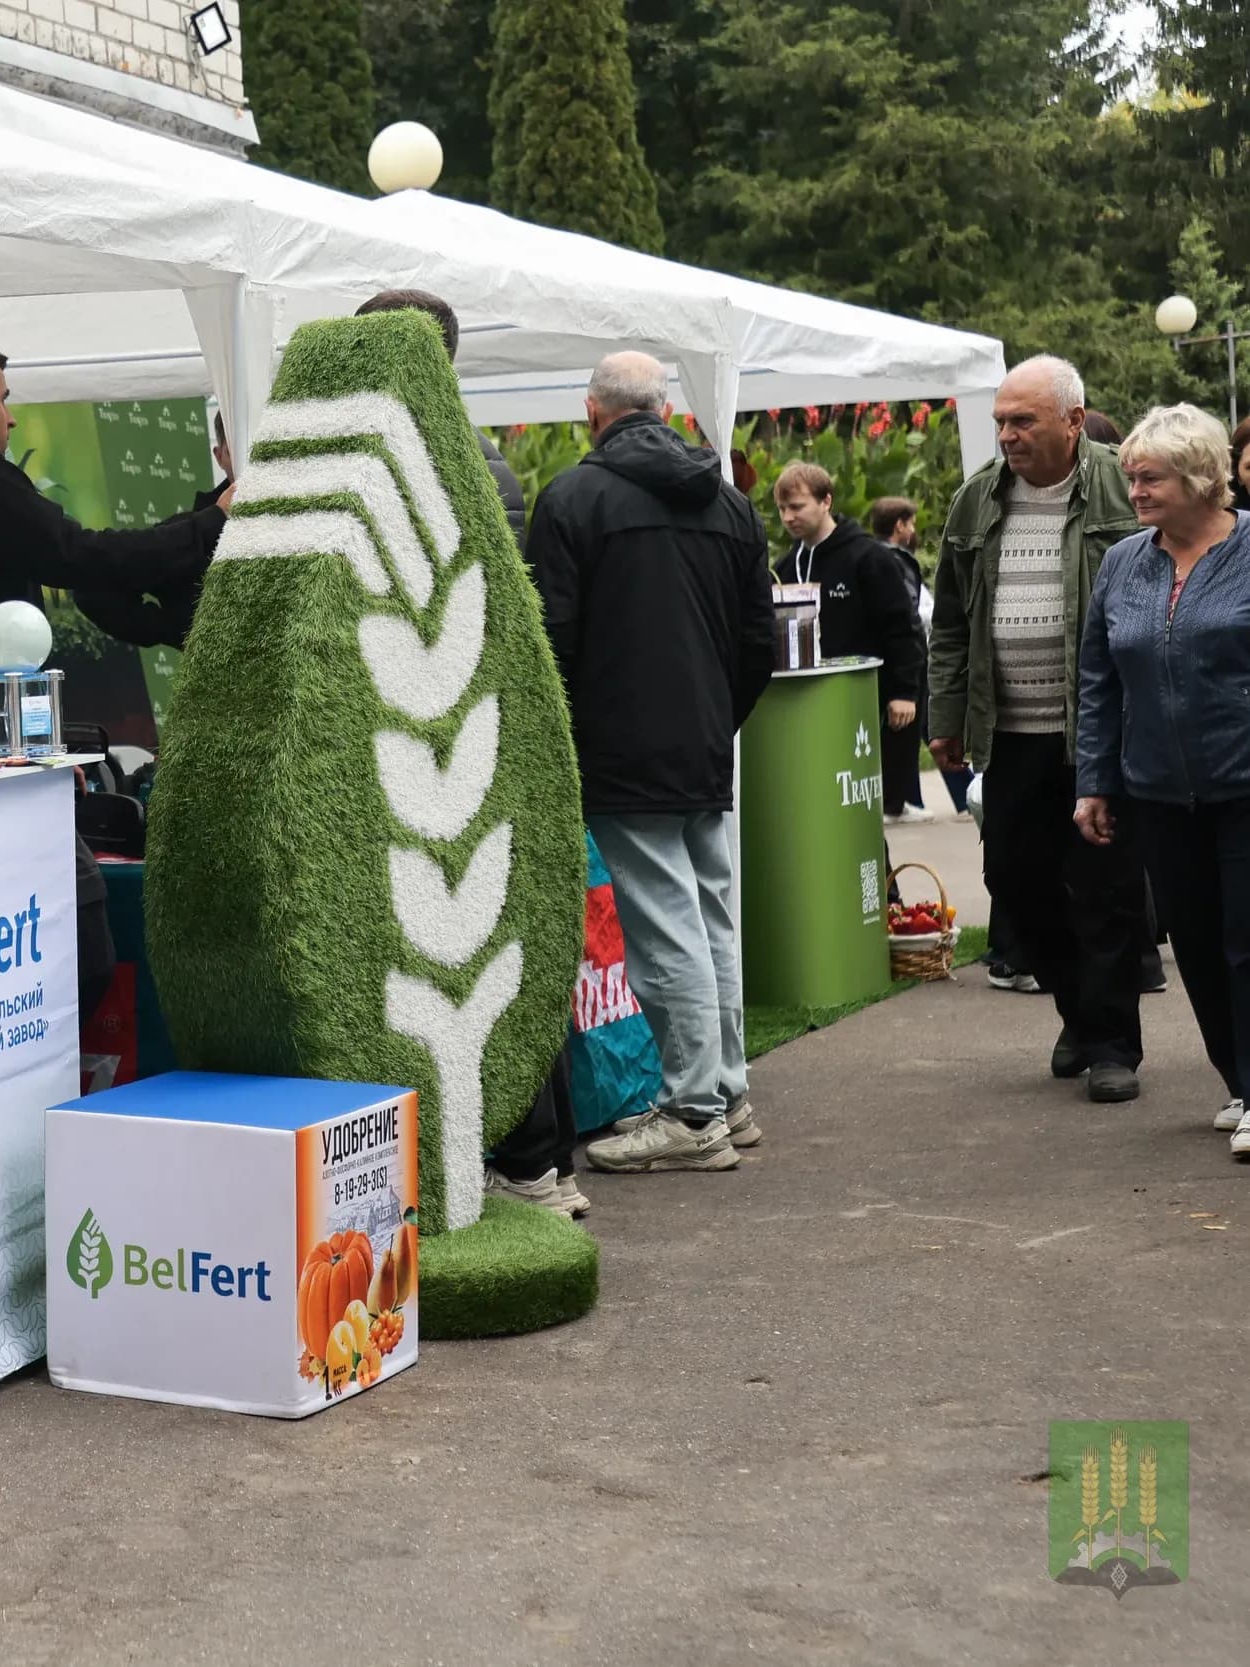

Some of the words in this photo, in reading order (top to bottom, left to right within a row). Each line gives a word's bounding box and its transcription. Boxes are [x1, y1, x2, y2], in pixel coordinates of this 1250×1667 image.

[8, 1017, 49, 1048] завод»
[322, 1106, 399, 1166] УДОБРЕНИЕ
[124, 1244, 272, 1302] BelFert
